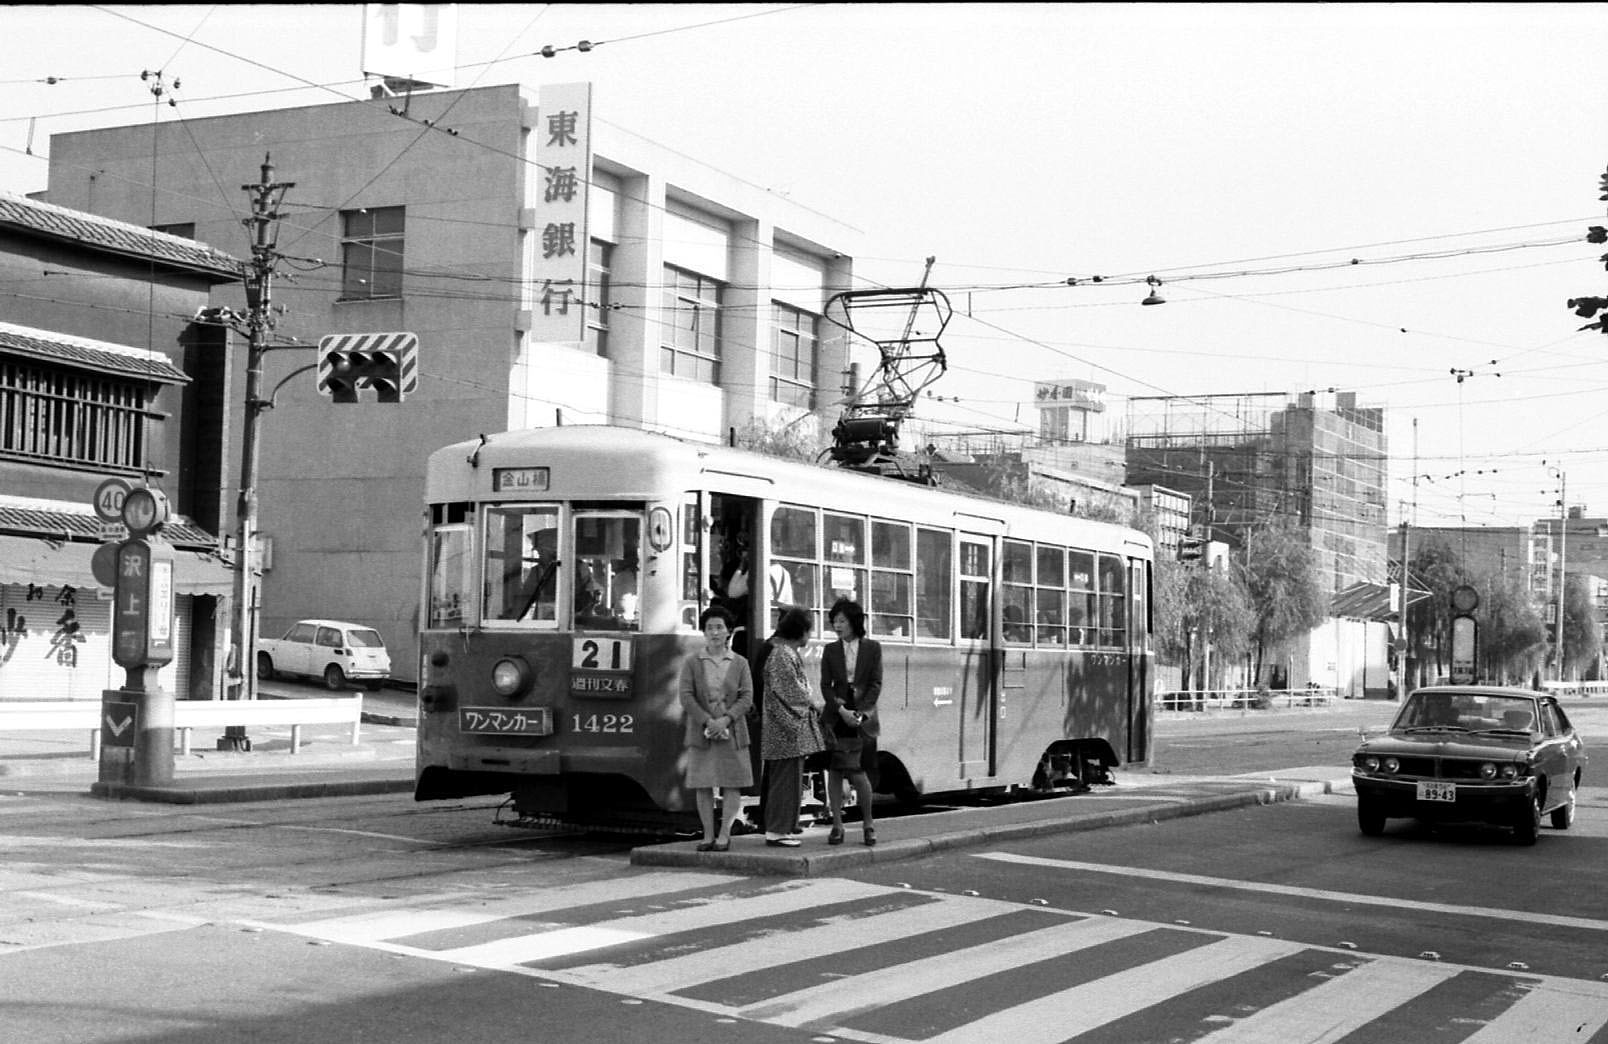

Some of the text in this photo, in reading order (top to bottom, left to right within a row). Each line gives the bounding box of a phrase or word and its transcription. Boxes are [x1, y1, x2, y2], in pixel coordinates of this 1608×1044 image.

[540, 110, 578, 316] 東海銀行
[101, 490, 125, 512] 40
[581, 640, 621, 669] 21
[465, 711, 538, 731] ワンマンカー
[572, 714, 634, 733] 1422
